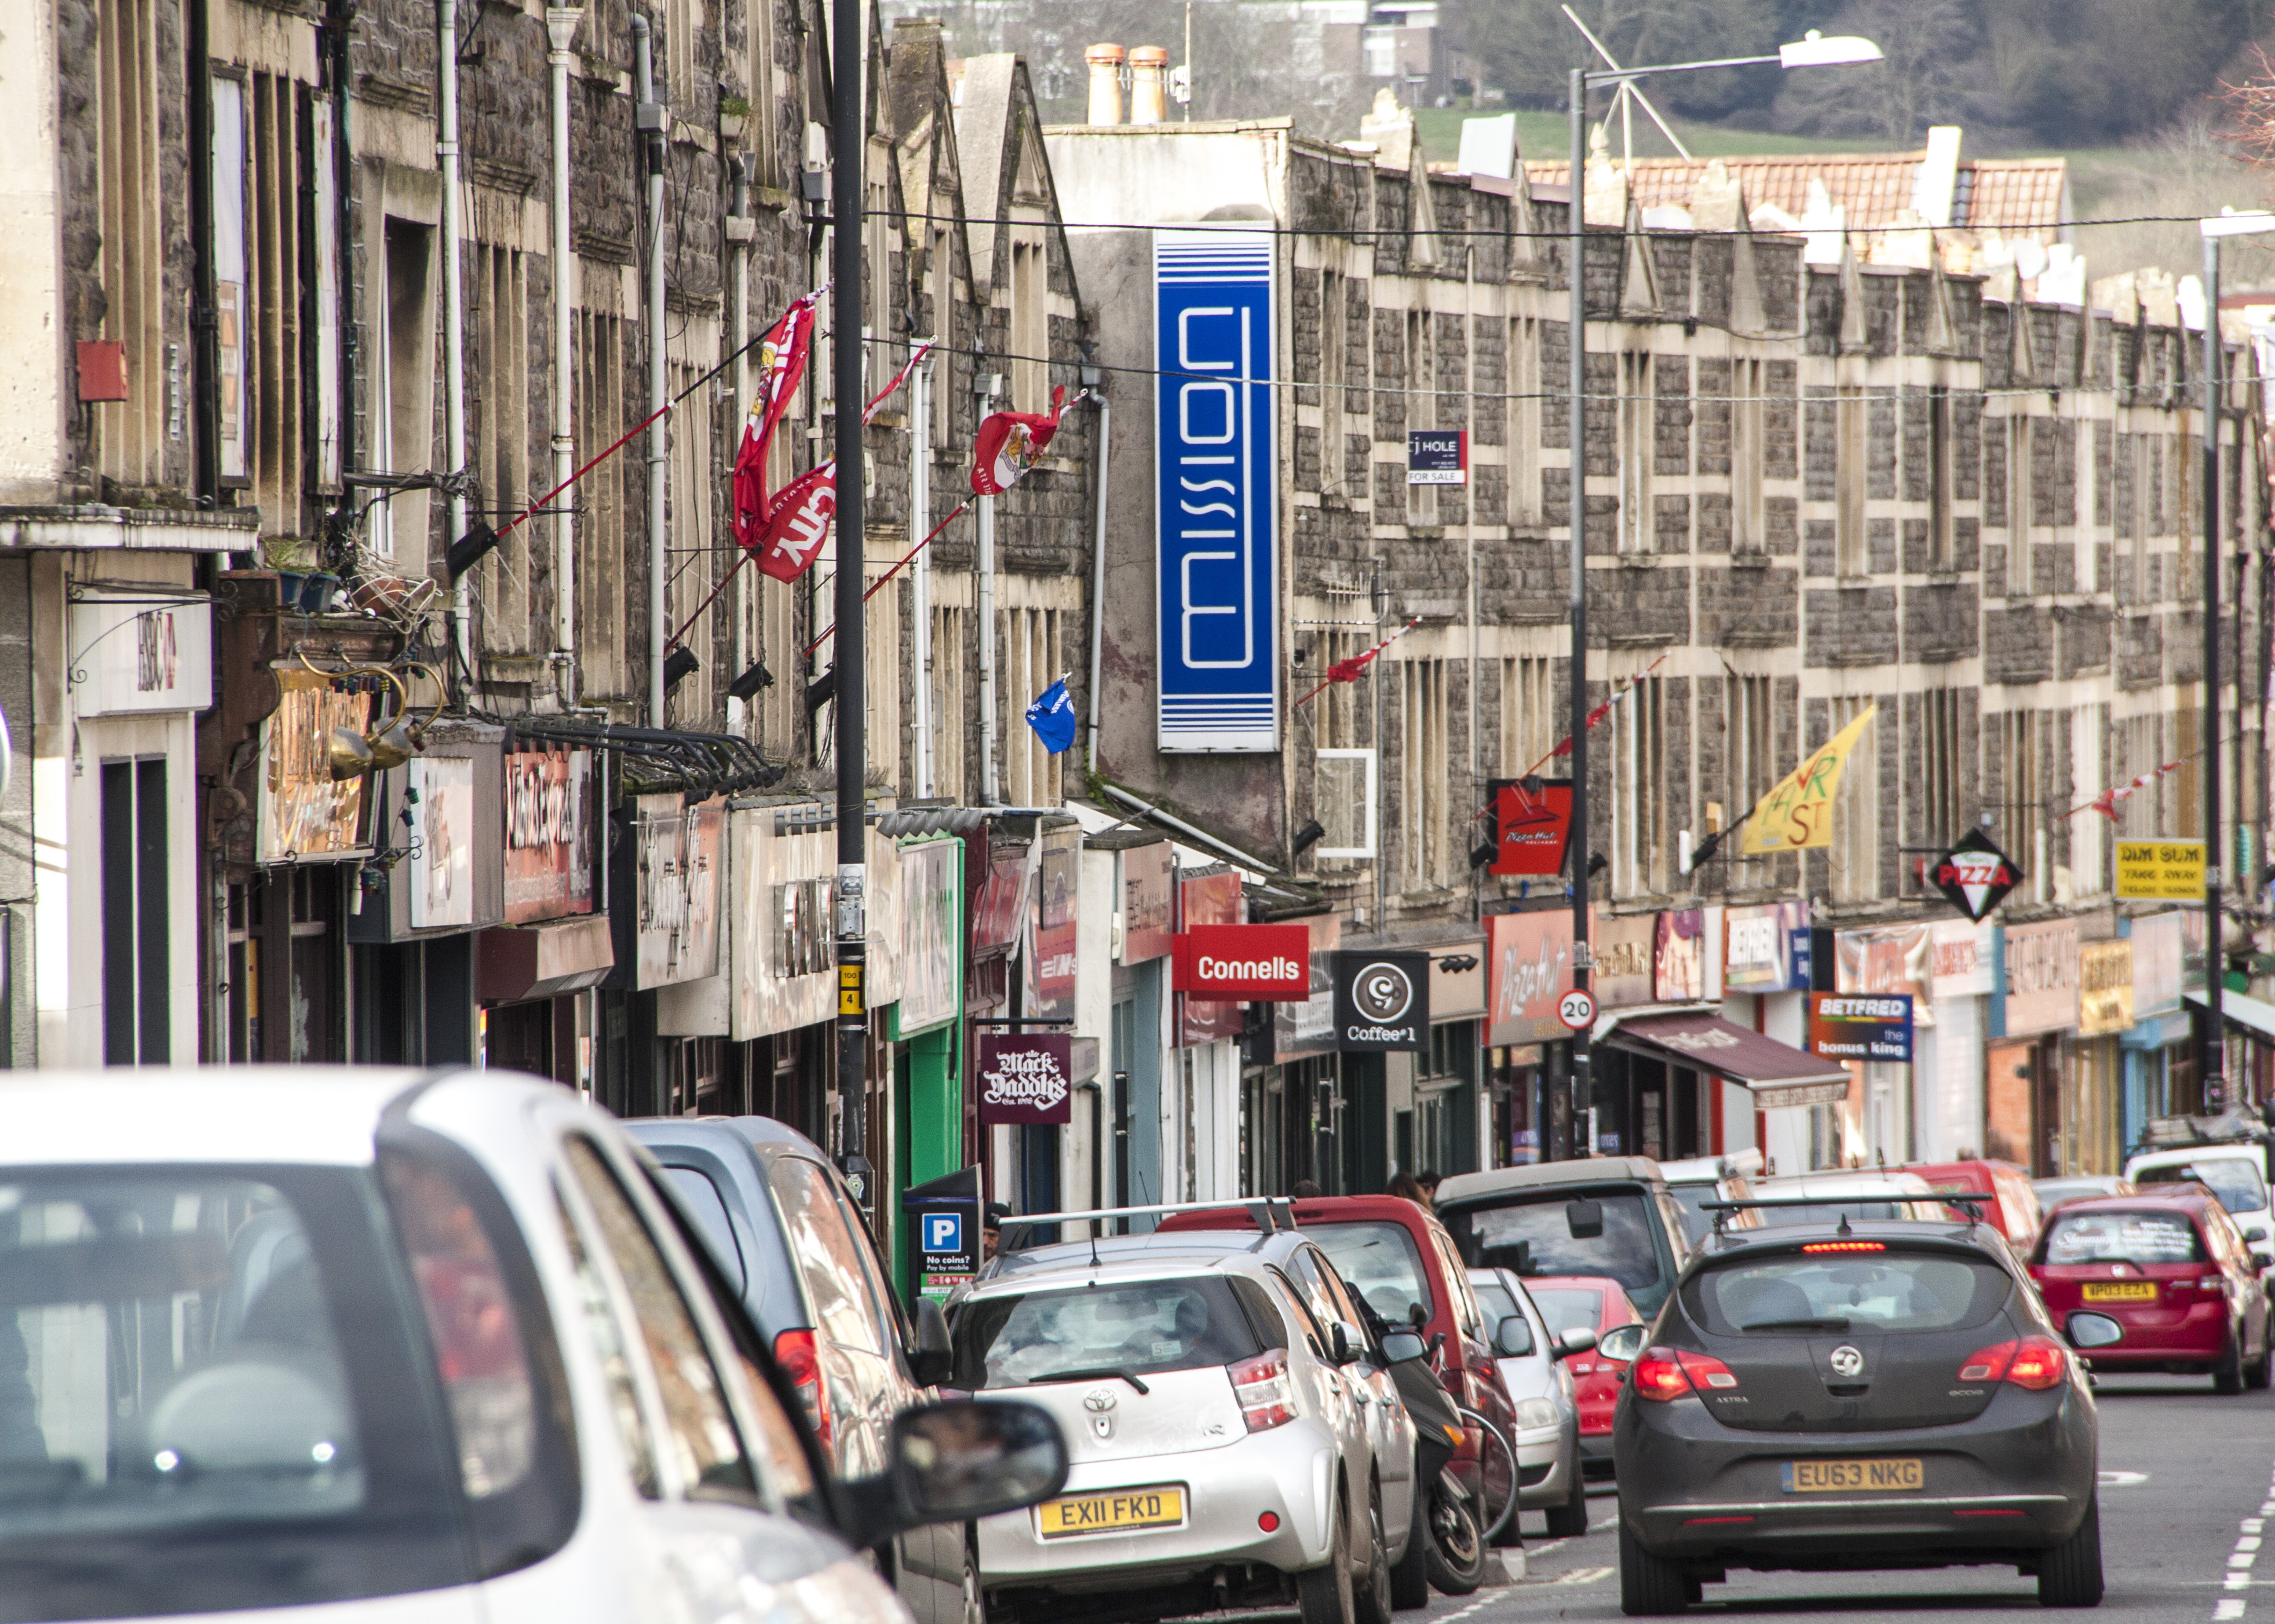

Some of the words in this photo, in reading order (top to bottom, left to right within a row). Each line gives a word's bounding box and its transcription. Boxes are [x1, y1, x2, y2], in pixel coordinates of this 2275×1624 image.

[1422, 441, 1457, 452] HOLE
[1409, 473, 1428, 481] FOR
[1432, 473, 1455, 481] SALE
[1505, 831, 1533, 843] Pizza
[1535, 830, 1557, 840] Hut
[2120, 847, 2153, 862] DIM
[2159, 847, 2200, 862] SUM
[1938, 864, 2011, 886] PIZZA
[2163, 870, 2197, 880] AWAY
[1198, 956, 1299, 980] Connells
[1497, 944, 1535, 1023] Pizza
[1535, 931, 1566, 1005] Hut
[846, 994, 853, 1004] 4
[1818, 998, 1906, 1016] BETFRED
[1564, 1001, 1590, 1017] 20
[1884, 1029, 1904, 1041] the
[1818, 1041, 1866, 1054] bonus
[1870, 1041, 1905, 1058] king
[996, 1051, 1060, 1077] Mack
[933, 1219, 956, 1246] P
[926, 1256, 940, 1264] No
[942, 1255, 970, 1264] coins?
[1798, 1462, 1861, 1486] EU63
[1869, 1461, 1918, 1485] NKG
[1061, 1499, 1107, 1526] EX11
[1113, 1494, 1162, 1521] FKD
